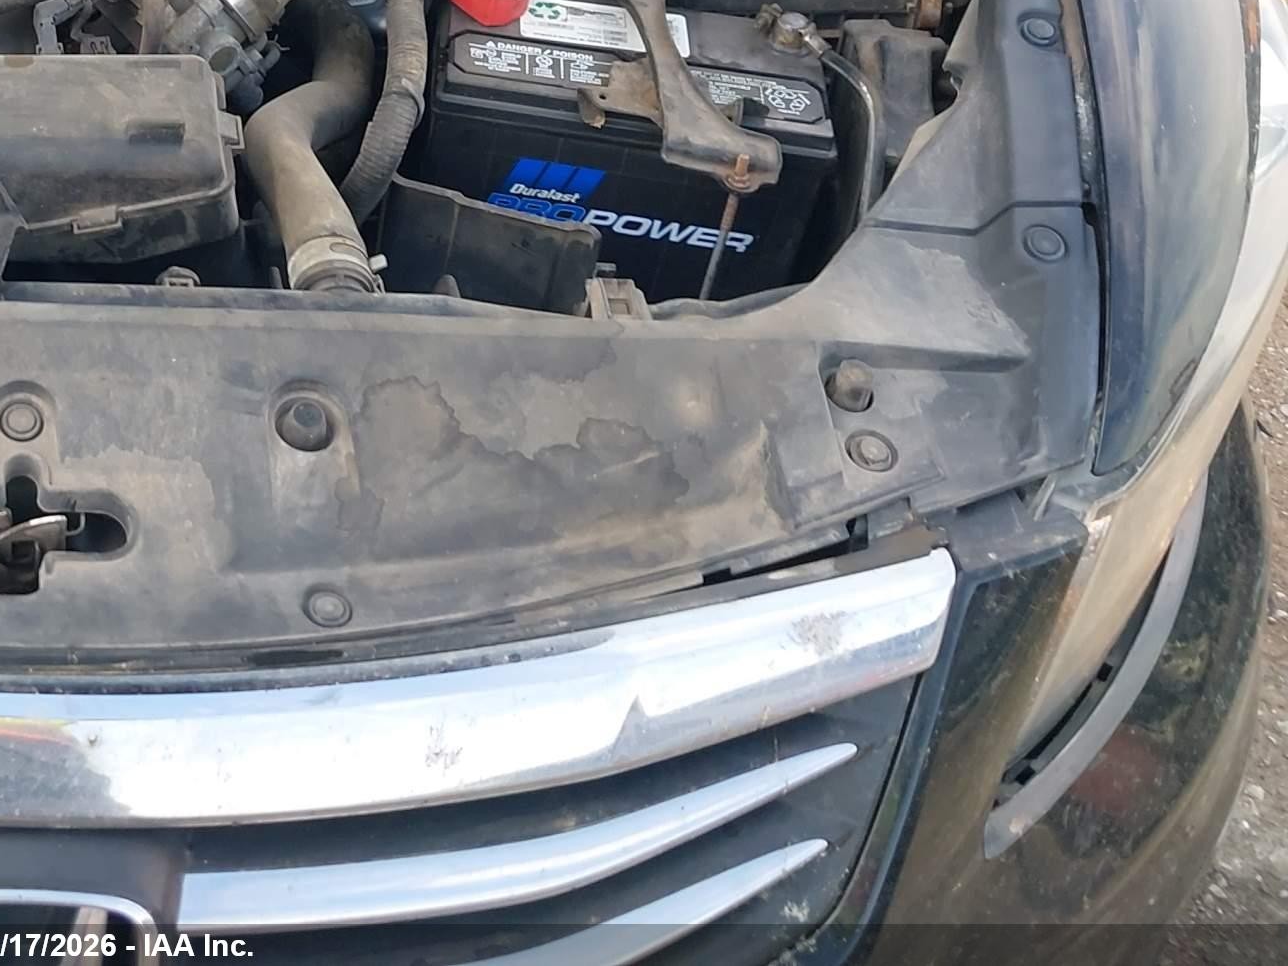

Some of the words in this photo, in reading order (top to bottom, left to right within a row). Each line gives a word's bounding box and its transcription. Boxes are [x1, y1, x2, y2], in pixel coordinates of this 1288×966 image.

[496, 41, 543, 56] DANGER
[552, 49, 594, 62] POISON
[509, 182, 581, 204] Duralast
